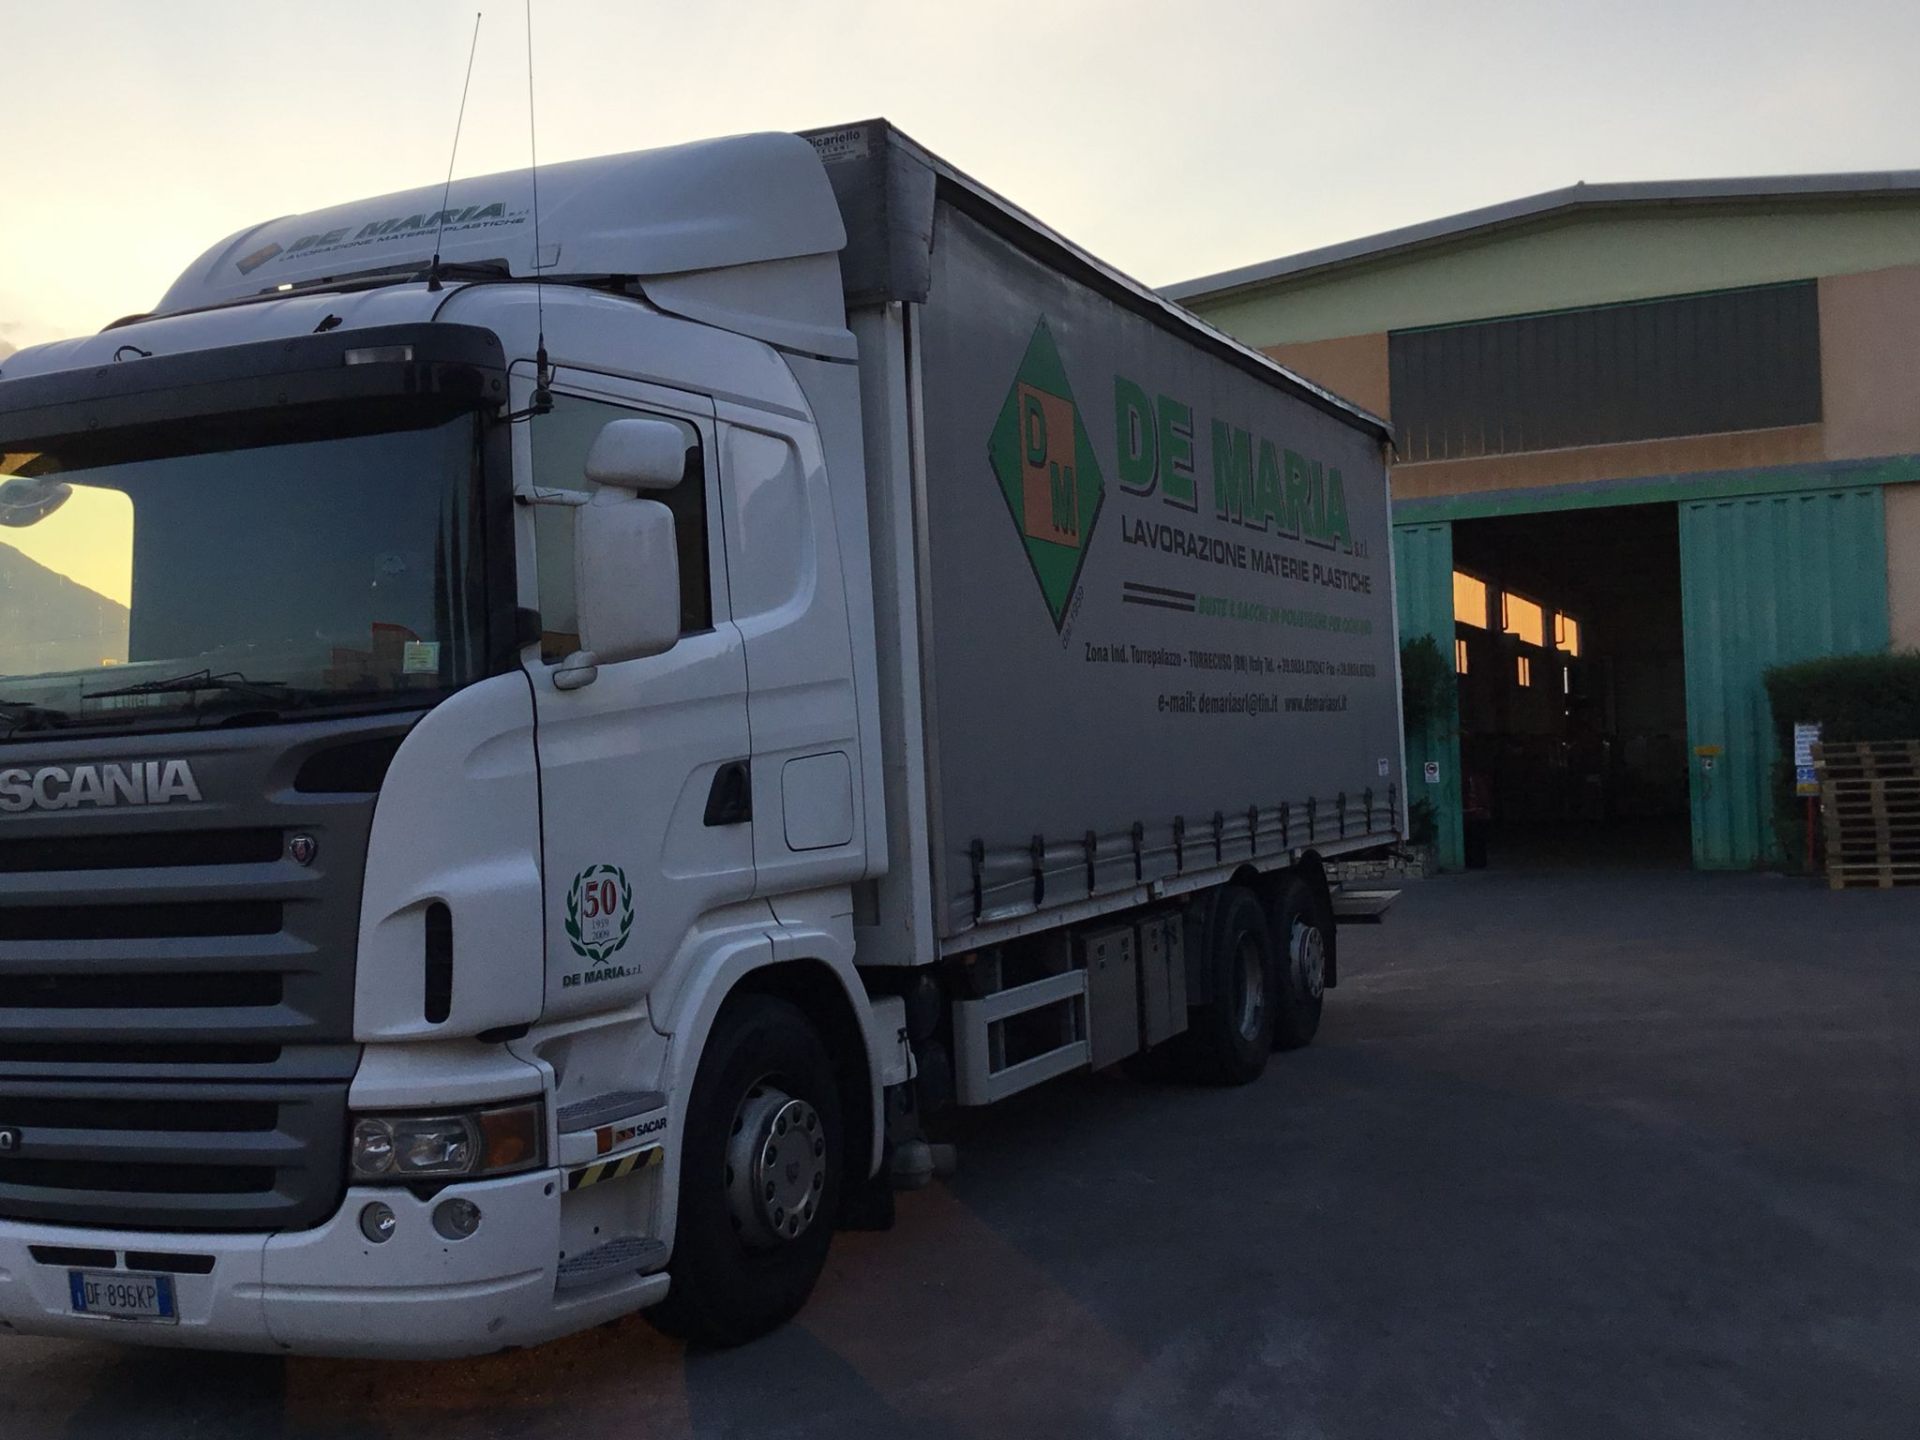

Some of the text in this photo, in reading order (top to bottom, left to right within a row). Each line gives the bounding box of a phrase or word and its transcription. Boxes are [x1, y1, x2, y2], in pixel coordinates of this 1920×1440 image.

[286, 227, 352, 254] DE
[353, 202, 506, 241] MARIA
[376, 228, 438, 243] MATERIE
[442, 216, 526, 233] PLASTICHE
[1024, 393, 1047, 468] D
[1115, 375, 1198, 514] DE
[1211, 417, 1352, 556] MARIA
[1121, 514, 1371, 594] LAVORAZIONE MATERIE PLASTICHE
[1085, 642, 1108, 662] Zona
[1130, 645, 1181, 669] Torrepalazzo
[1188, 650, 1231, 670] TORRECUSO
[1158, 691, 1195, 712] e-mail:
[0, 759, 202, 812] SCANIA
[583, 879, 616, 918] 50
[562, 973, 581, 988] DE
[584, 966, 625, 983] MARIA
[636, 1118, 667, 1136] SACAR
